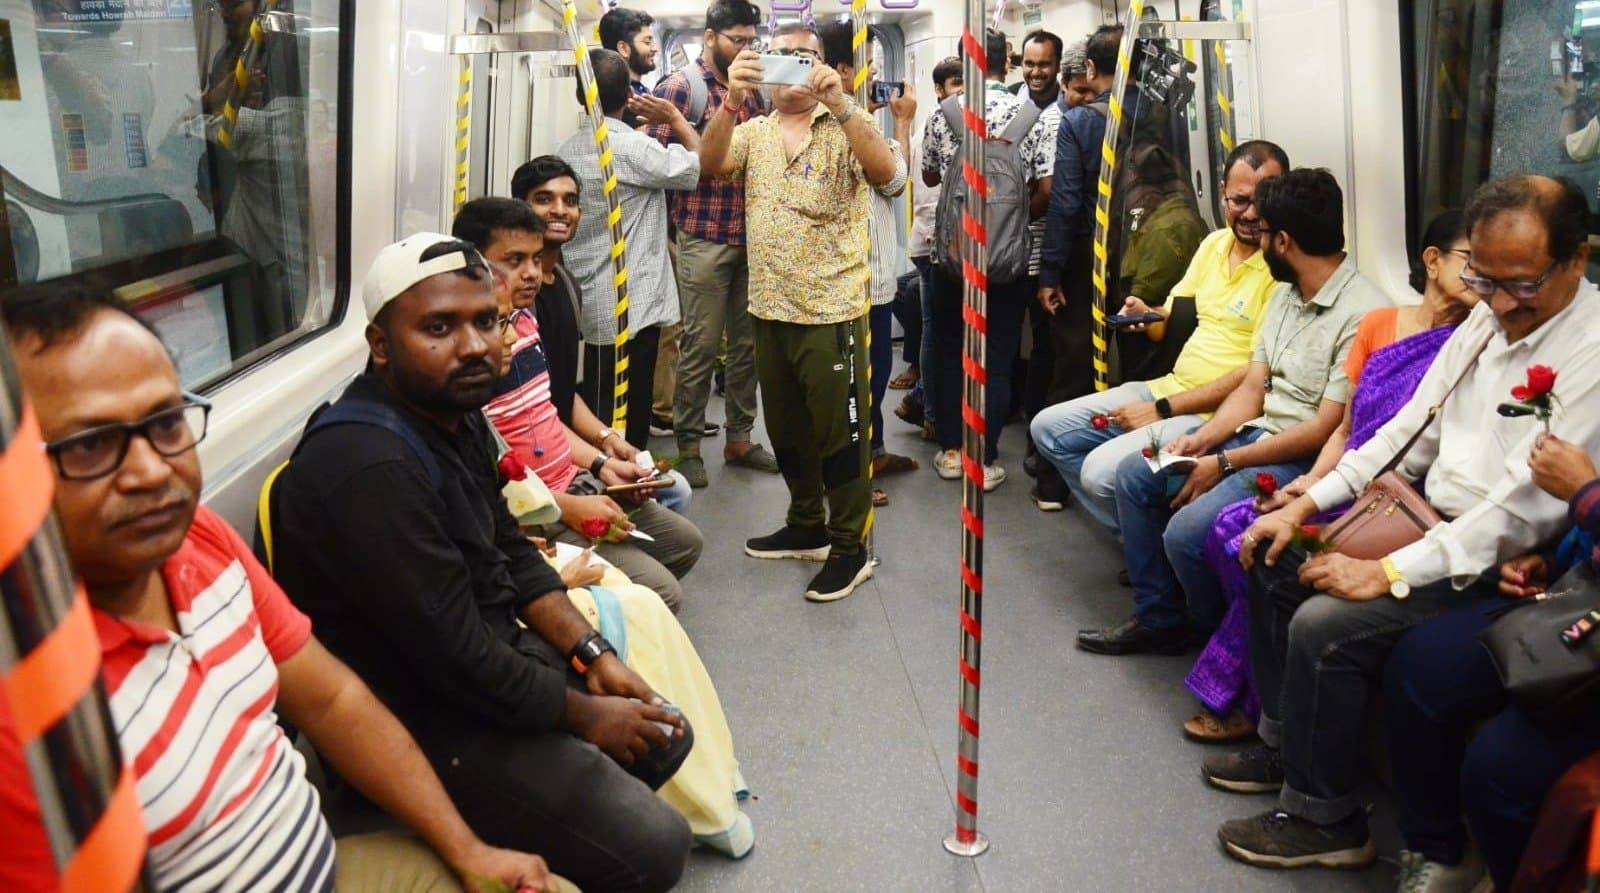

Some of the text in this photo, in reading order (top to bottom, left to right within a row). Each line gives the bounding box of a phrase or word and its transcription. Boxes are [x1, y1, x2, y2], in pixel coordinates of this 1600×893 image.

[62, 12, 99, 20] Towards
[102, 10, 135, 19] Howrah
[849, 397, 858, 423] PUSH
